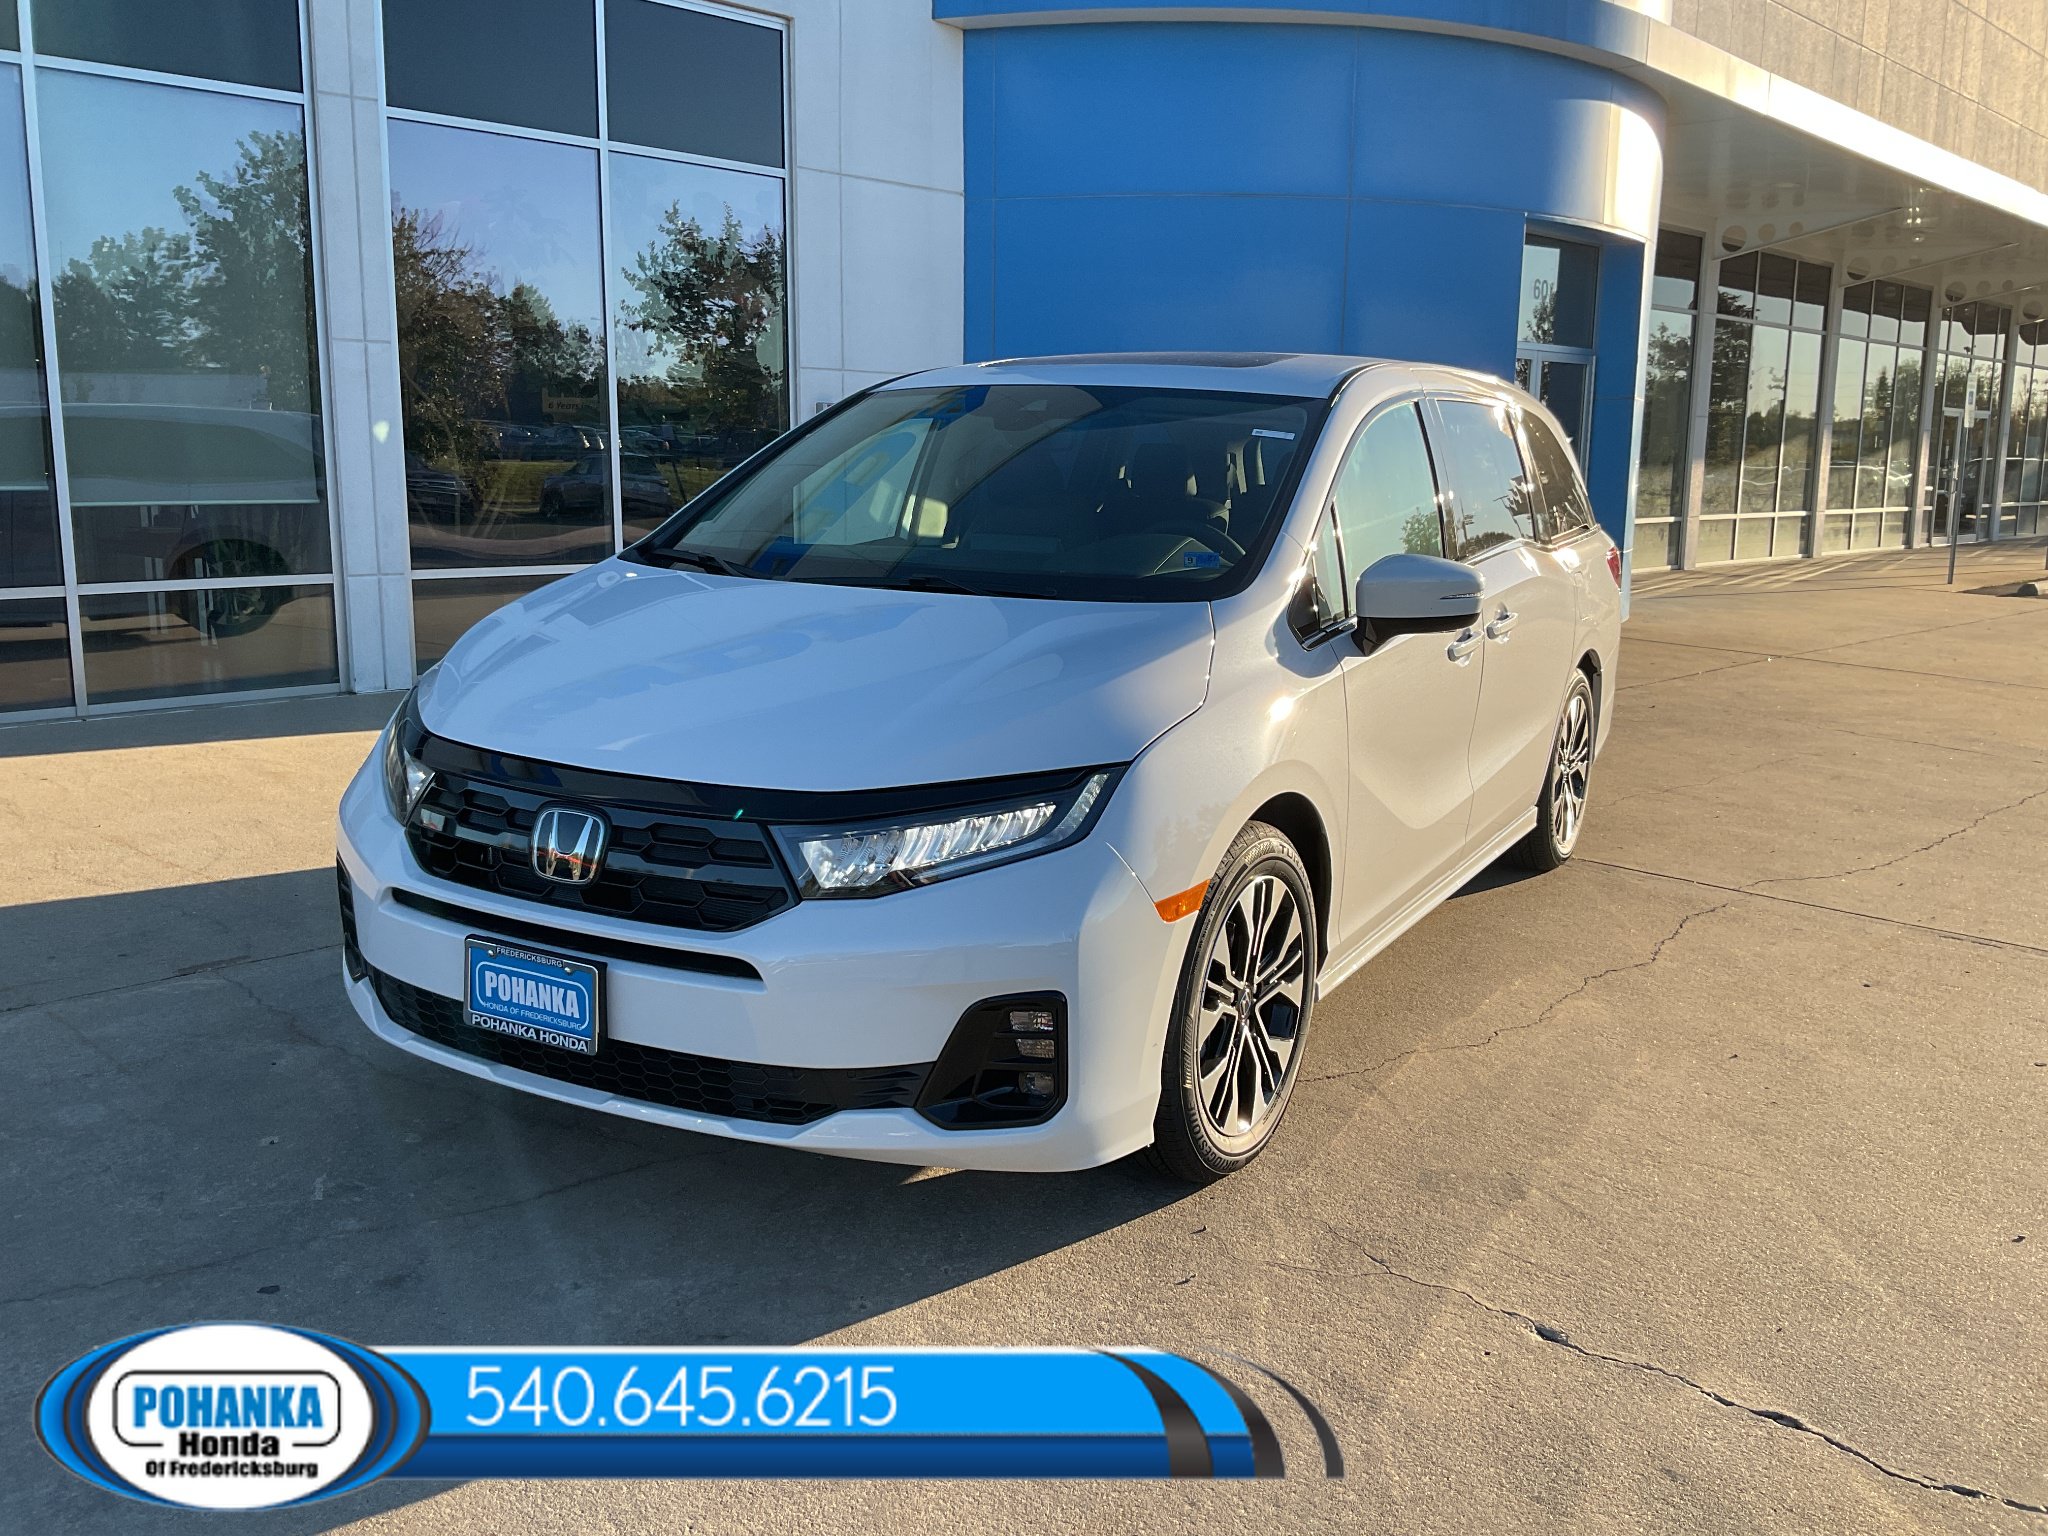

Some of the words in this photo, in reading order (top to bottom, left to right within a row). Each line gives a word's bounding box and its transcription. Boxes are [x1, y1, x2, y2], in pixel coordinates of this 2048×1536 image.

[496, 946, 563, 968] FREDERICKSBURG
[484, 970, 580, 1019] POHANKA
[472, 1013, 537, 1040] POHANKA
[539, 1029, 588, 1052] HONDA
[483, 1001, 509, 1013] HONDA
[509, 1007, 520, 1015] OF
[520, 1010, 583, 1031] FREDERICKSBURG
